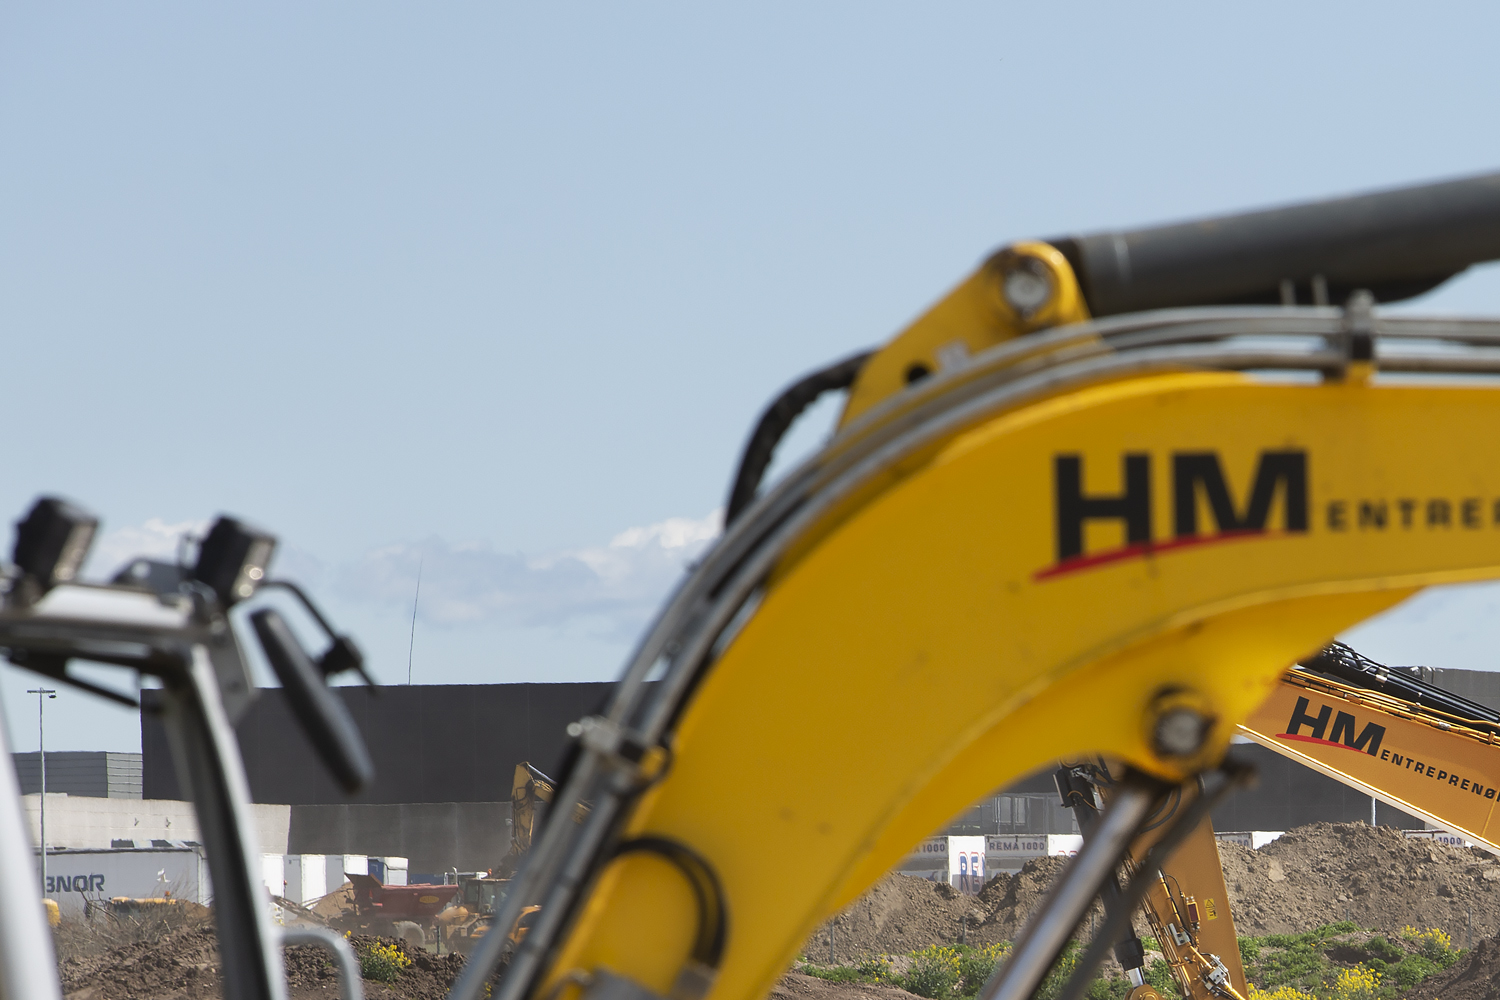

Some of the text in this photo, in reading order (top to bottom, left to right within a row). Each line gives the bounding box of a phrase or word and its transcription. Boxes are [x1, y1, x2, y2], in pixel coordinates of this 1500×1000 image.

[1053, 447, 1310, 563] HM
[1286, 695, 1386, 758] HM
[989, 841, 1045, 851] REMA 1000
